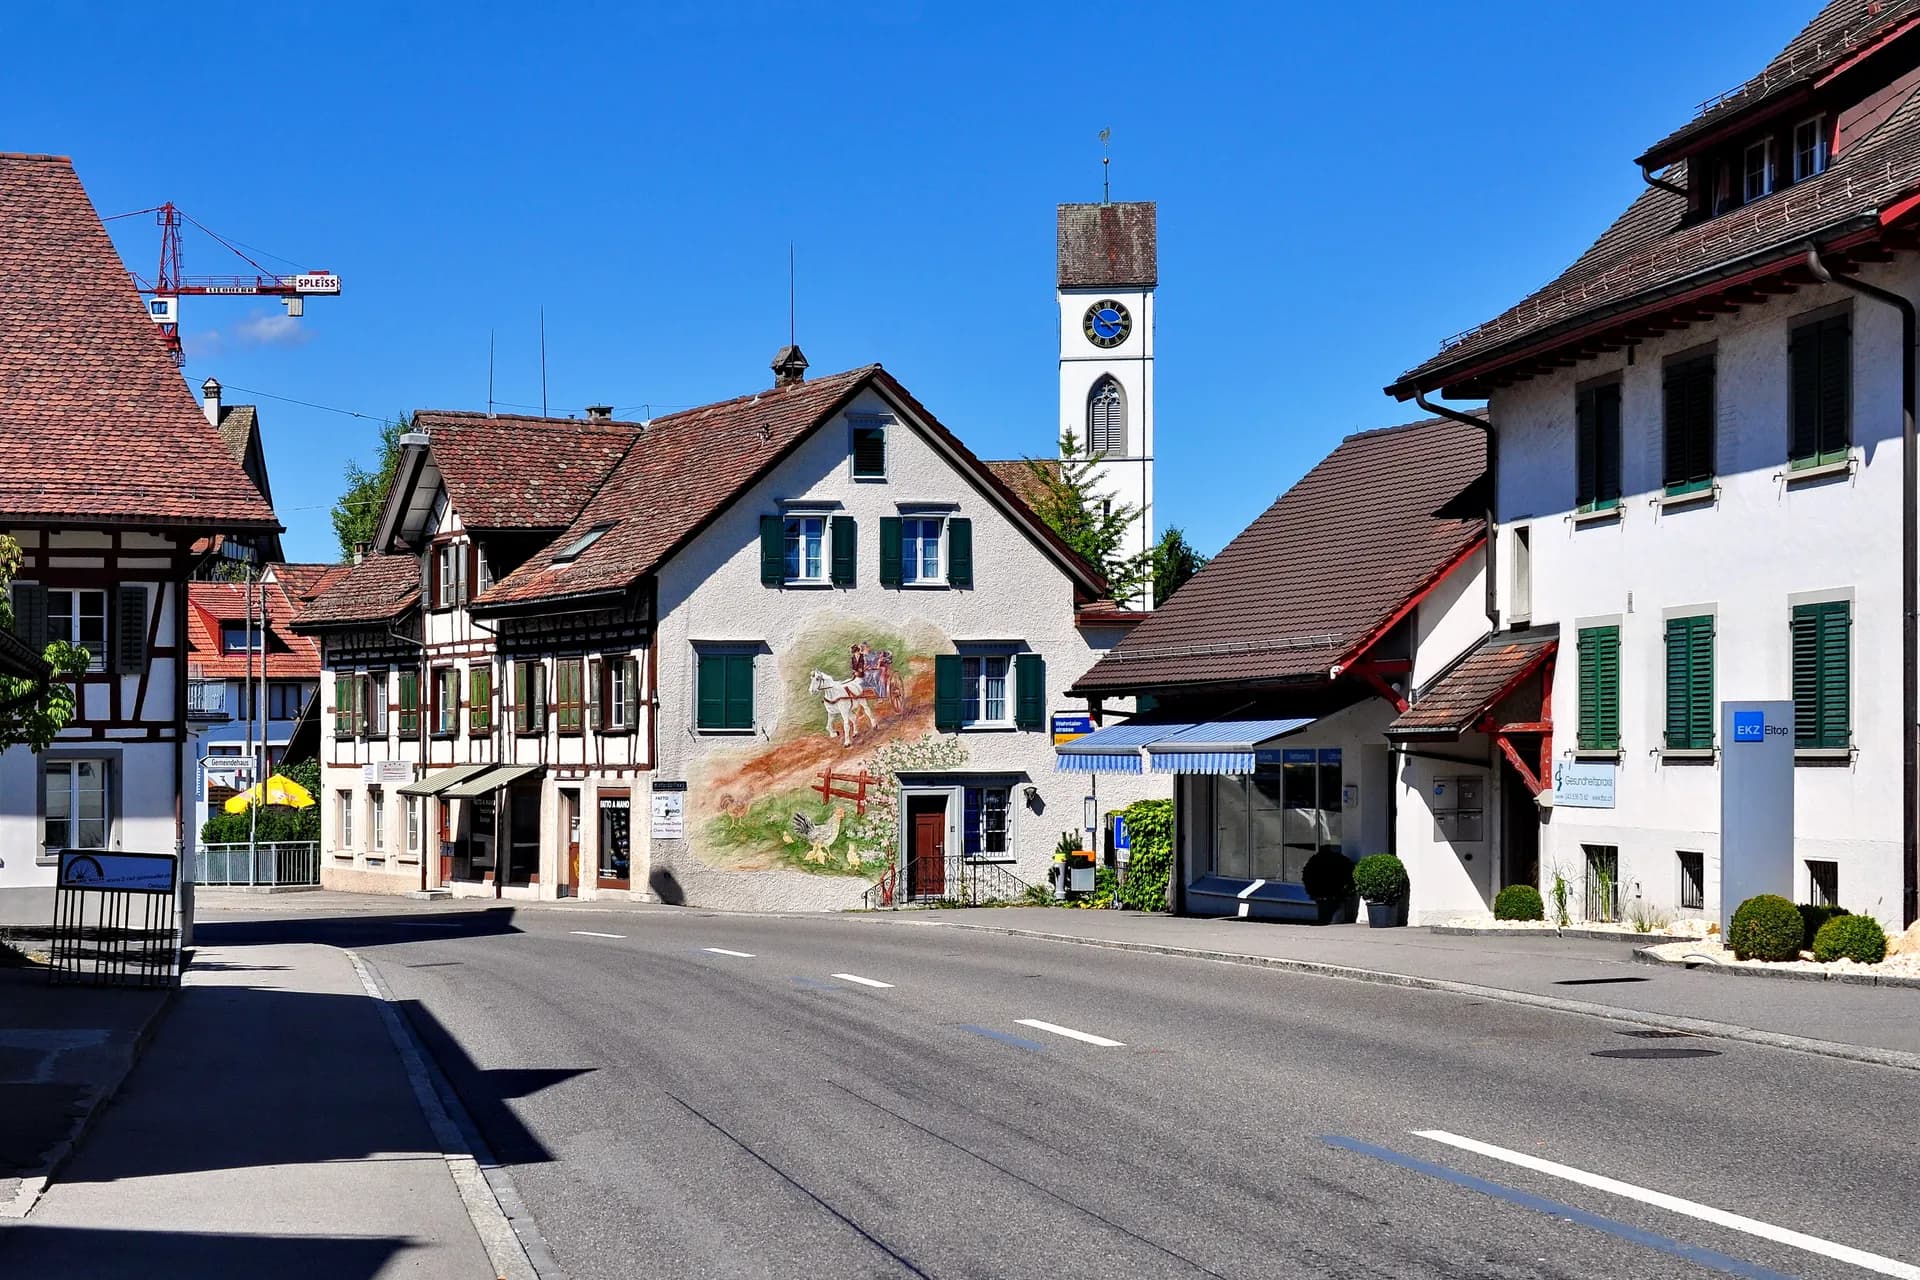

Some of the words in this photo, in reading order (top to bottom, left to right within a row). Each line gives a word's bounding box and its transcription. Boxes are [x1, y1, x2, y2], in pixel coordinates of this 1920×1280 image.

[1737, 725, 1760, 735] EKZ
[1764, 725, 1789, 737] Eltop
[211, 758, 250, 767] Gemeindehaus
[1564, 775, 1613, 787] Gesundheitspraxis
